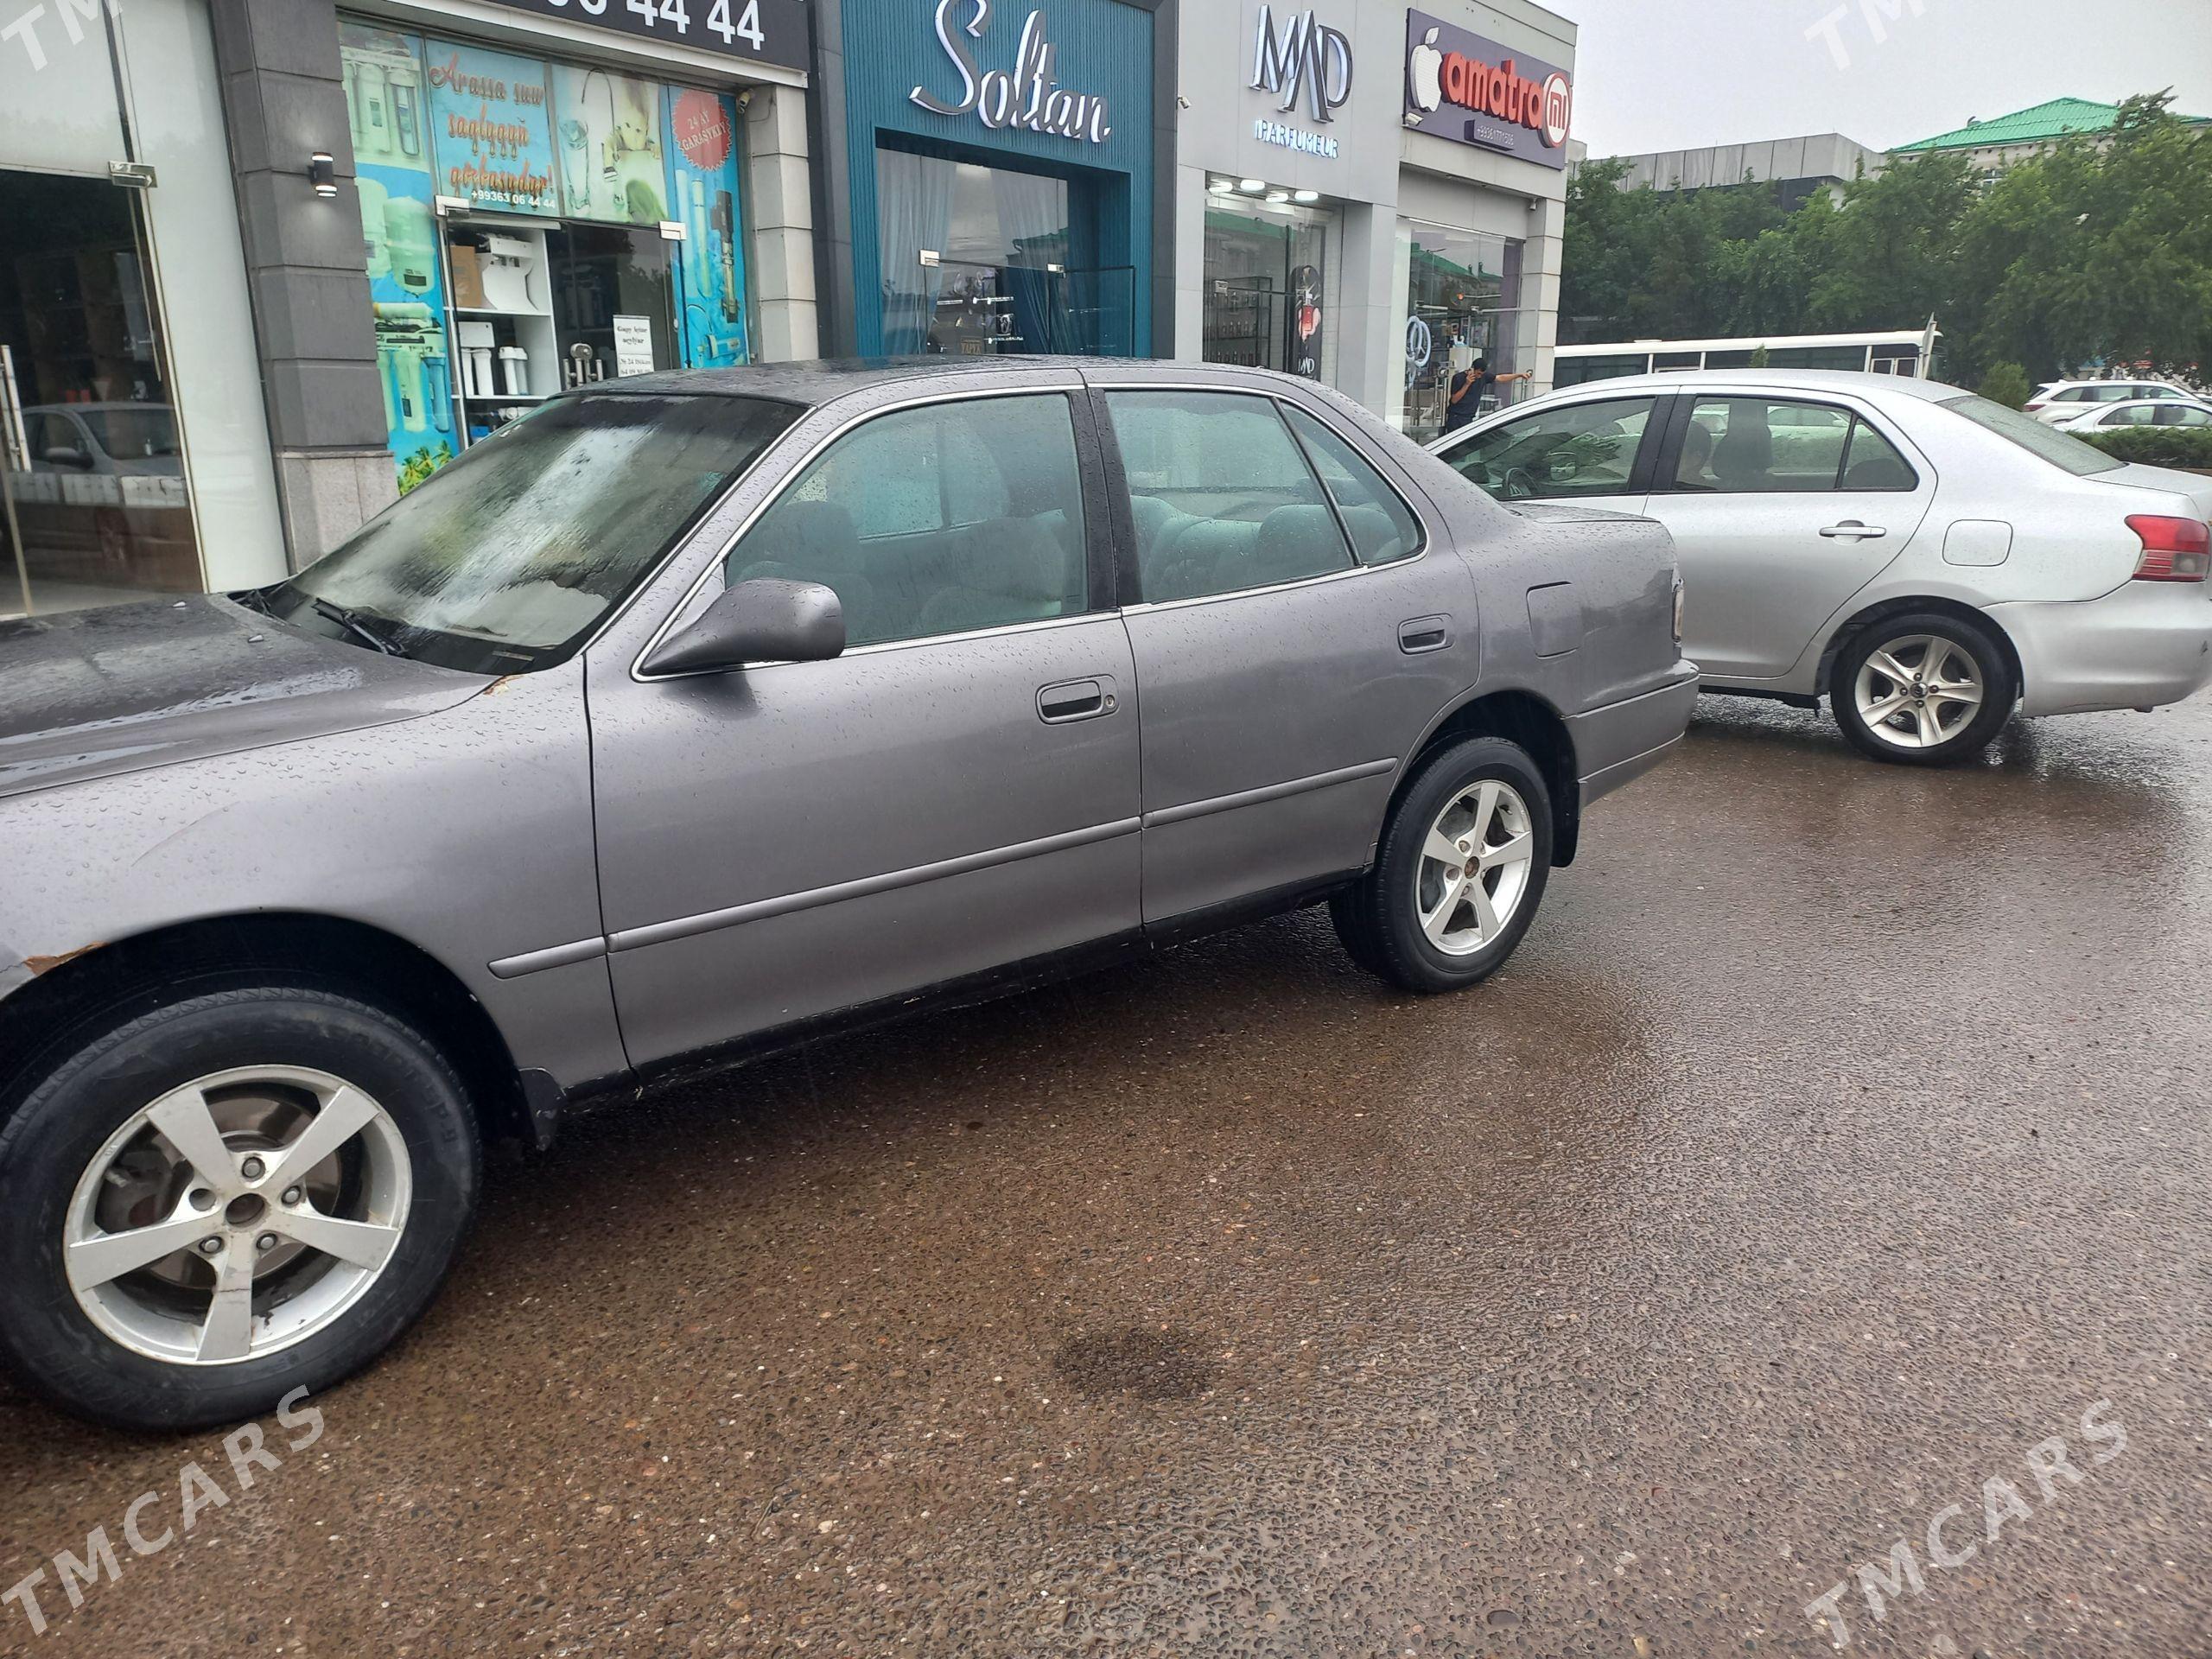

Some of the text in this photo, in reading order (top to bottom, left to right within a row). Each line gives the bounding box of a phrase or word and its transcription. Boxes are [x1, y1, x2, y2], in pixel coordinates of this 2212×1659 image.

[707, 0, 765, 50] 44
[429, 51, 543, 106] Arassa suw
[909, 0, 1112, 143] Soltan
[1249, 4, 1353, 124] MAD
[1442, 50, 1543, 130] amatra
[1255, 119, 1339, 159] PARFUMEUR
[471, 189, 556, 208] +99363 06 44 44
